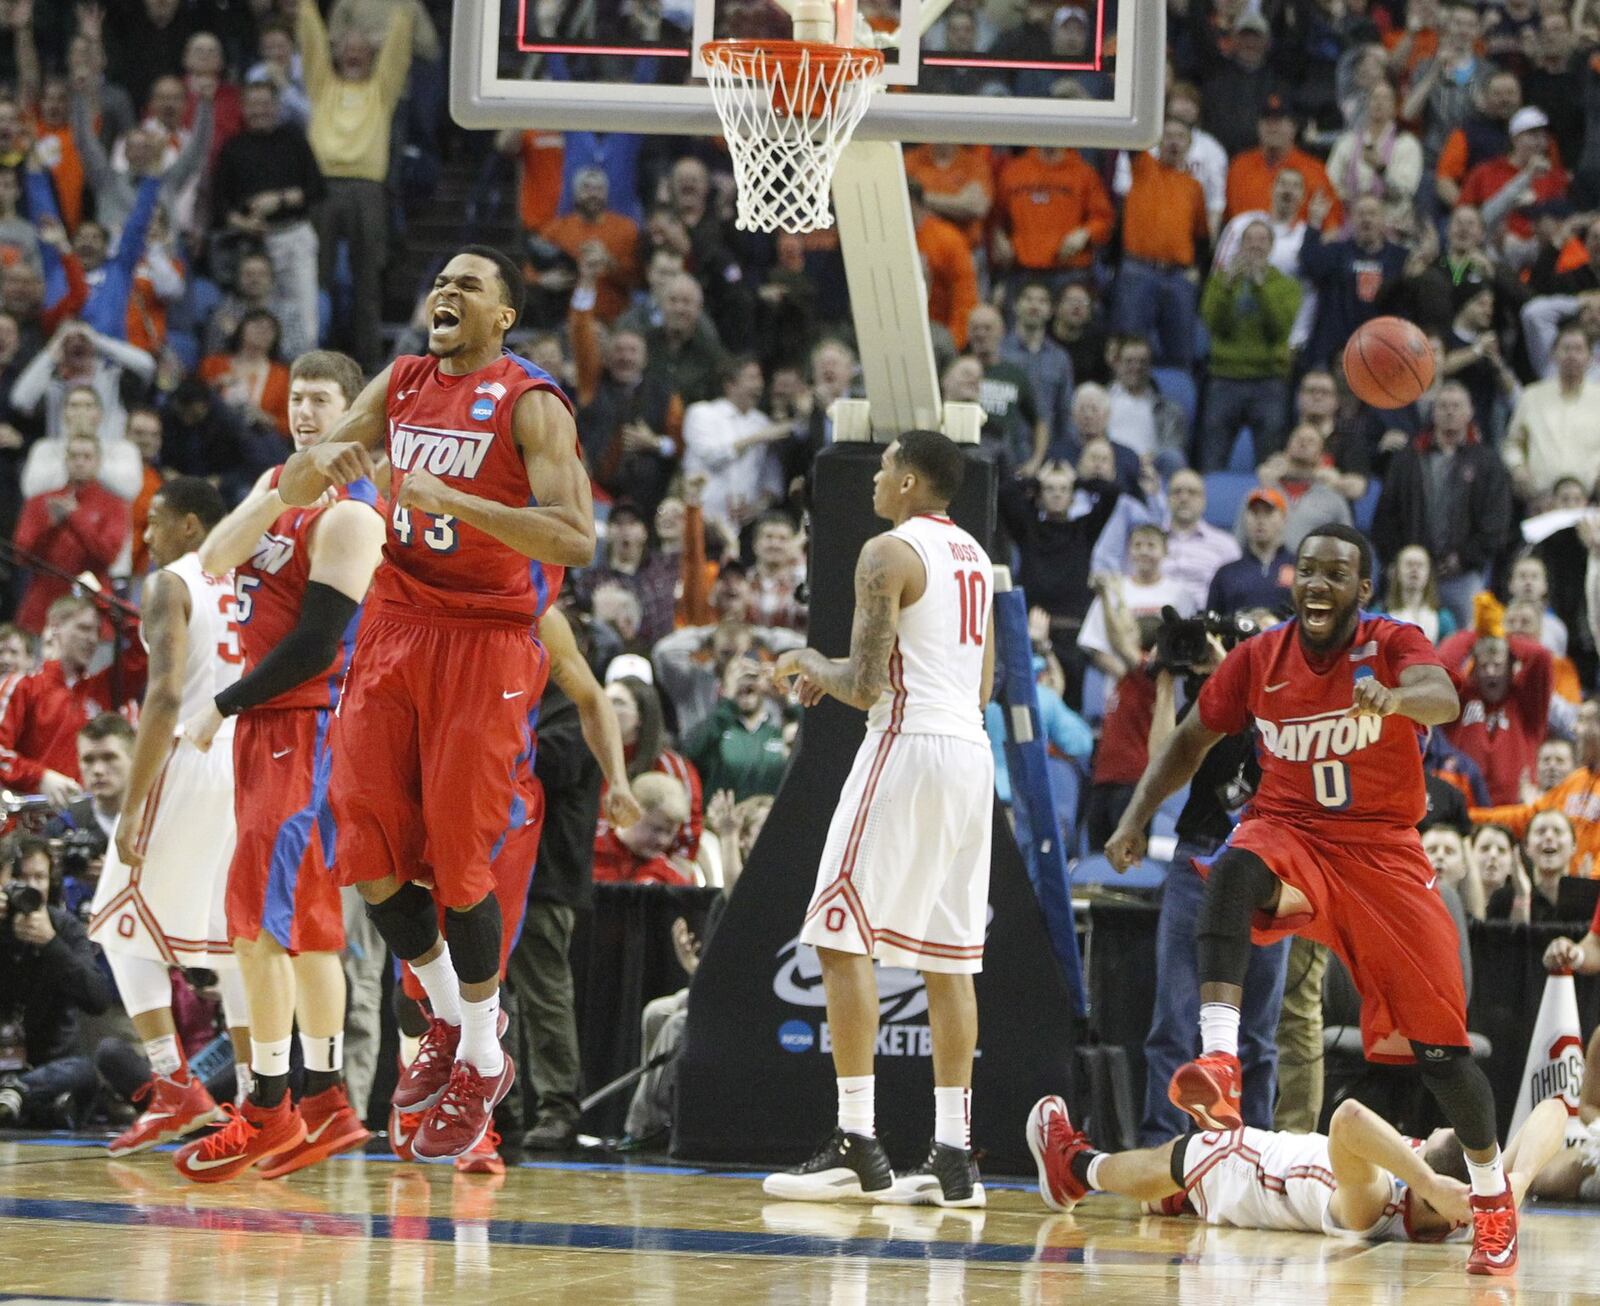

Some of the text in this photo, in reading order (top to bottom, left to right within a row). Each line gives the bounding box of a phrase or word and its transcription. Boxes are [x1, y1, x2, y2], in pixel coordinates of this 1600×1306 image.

[389, 417, 495, 480] AYTON
[392, 501, 456, 551] 43
[947, 541, 979, 562] ROSS
[954, 570, 987, 646] 10
[1255, 709, 1382, 762] DAYTON
[1312, 759, 1348, 807] 0
